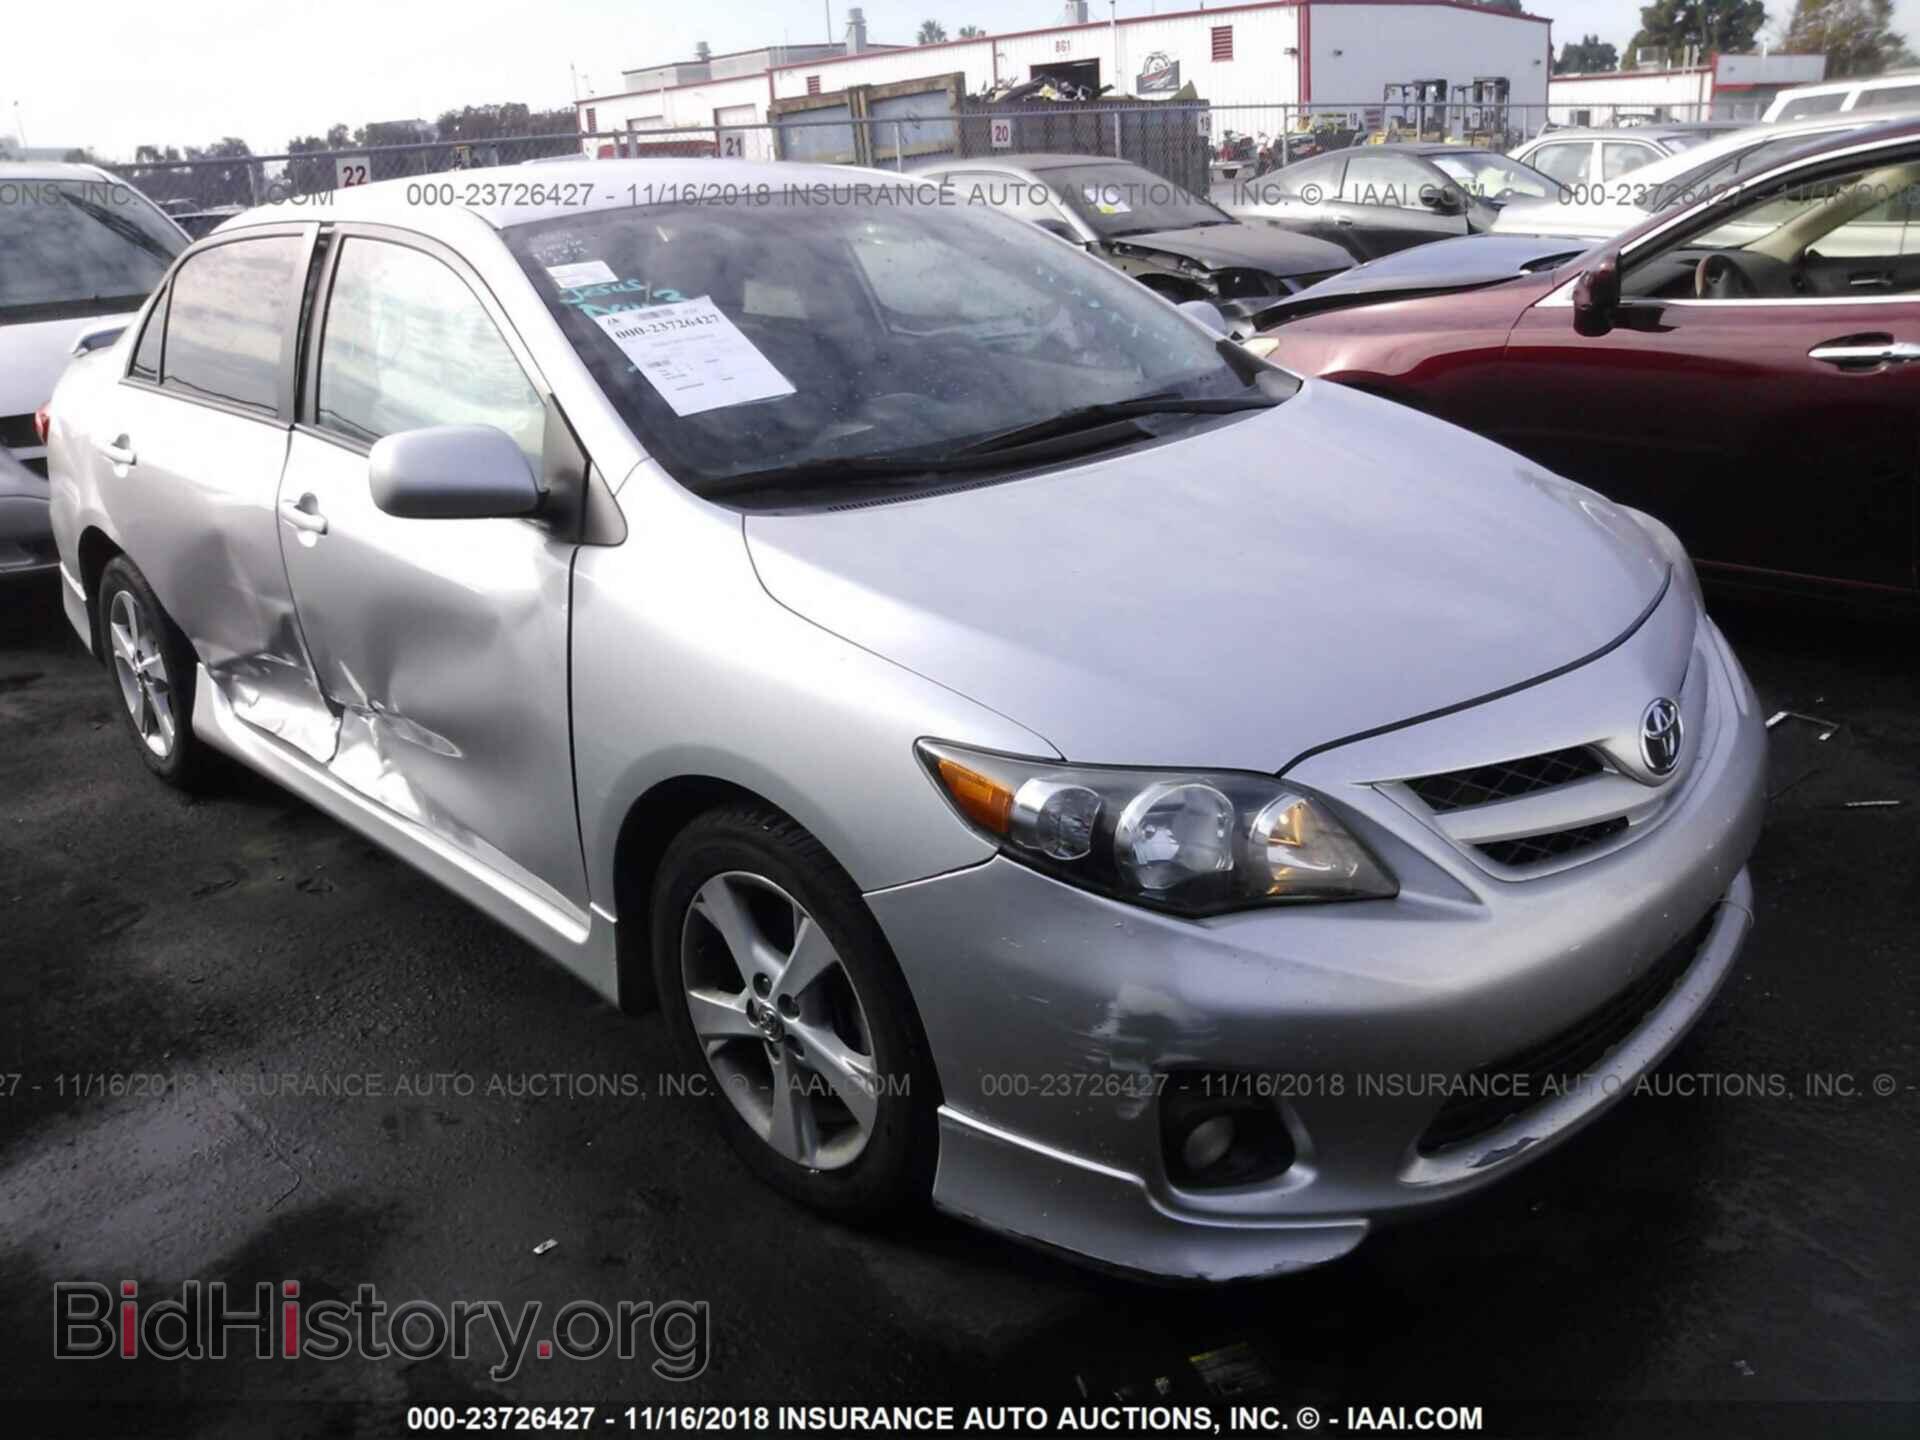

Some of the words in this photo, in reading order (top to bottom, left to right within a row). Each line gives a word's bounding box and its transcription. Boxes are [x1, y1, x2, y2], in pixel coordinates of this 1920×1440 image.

[994, 125, 1009, 142] 20
[725, 137, 742, 157] 21
[343, 165, 367, 188] 22
[615, 313, 720, 340] 000-23726427
